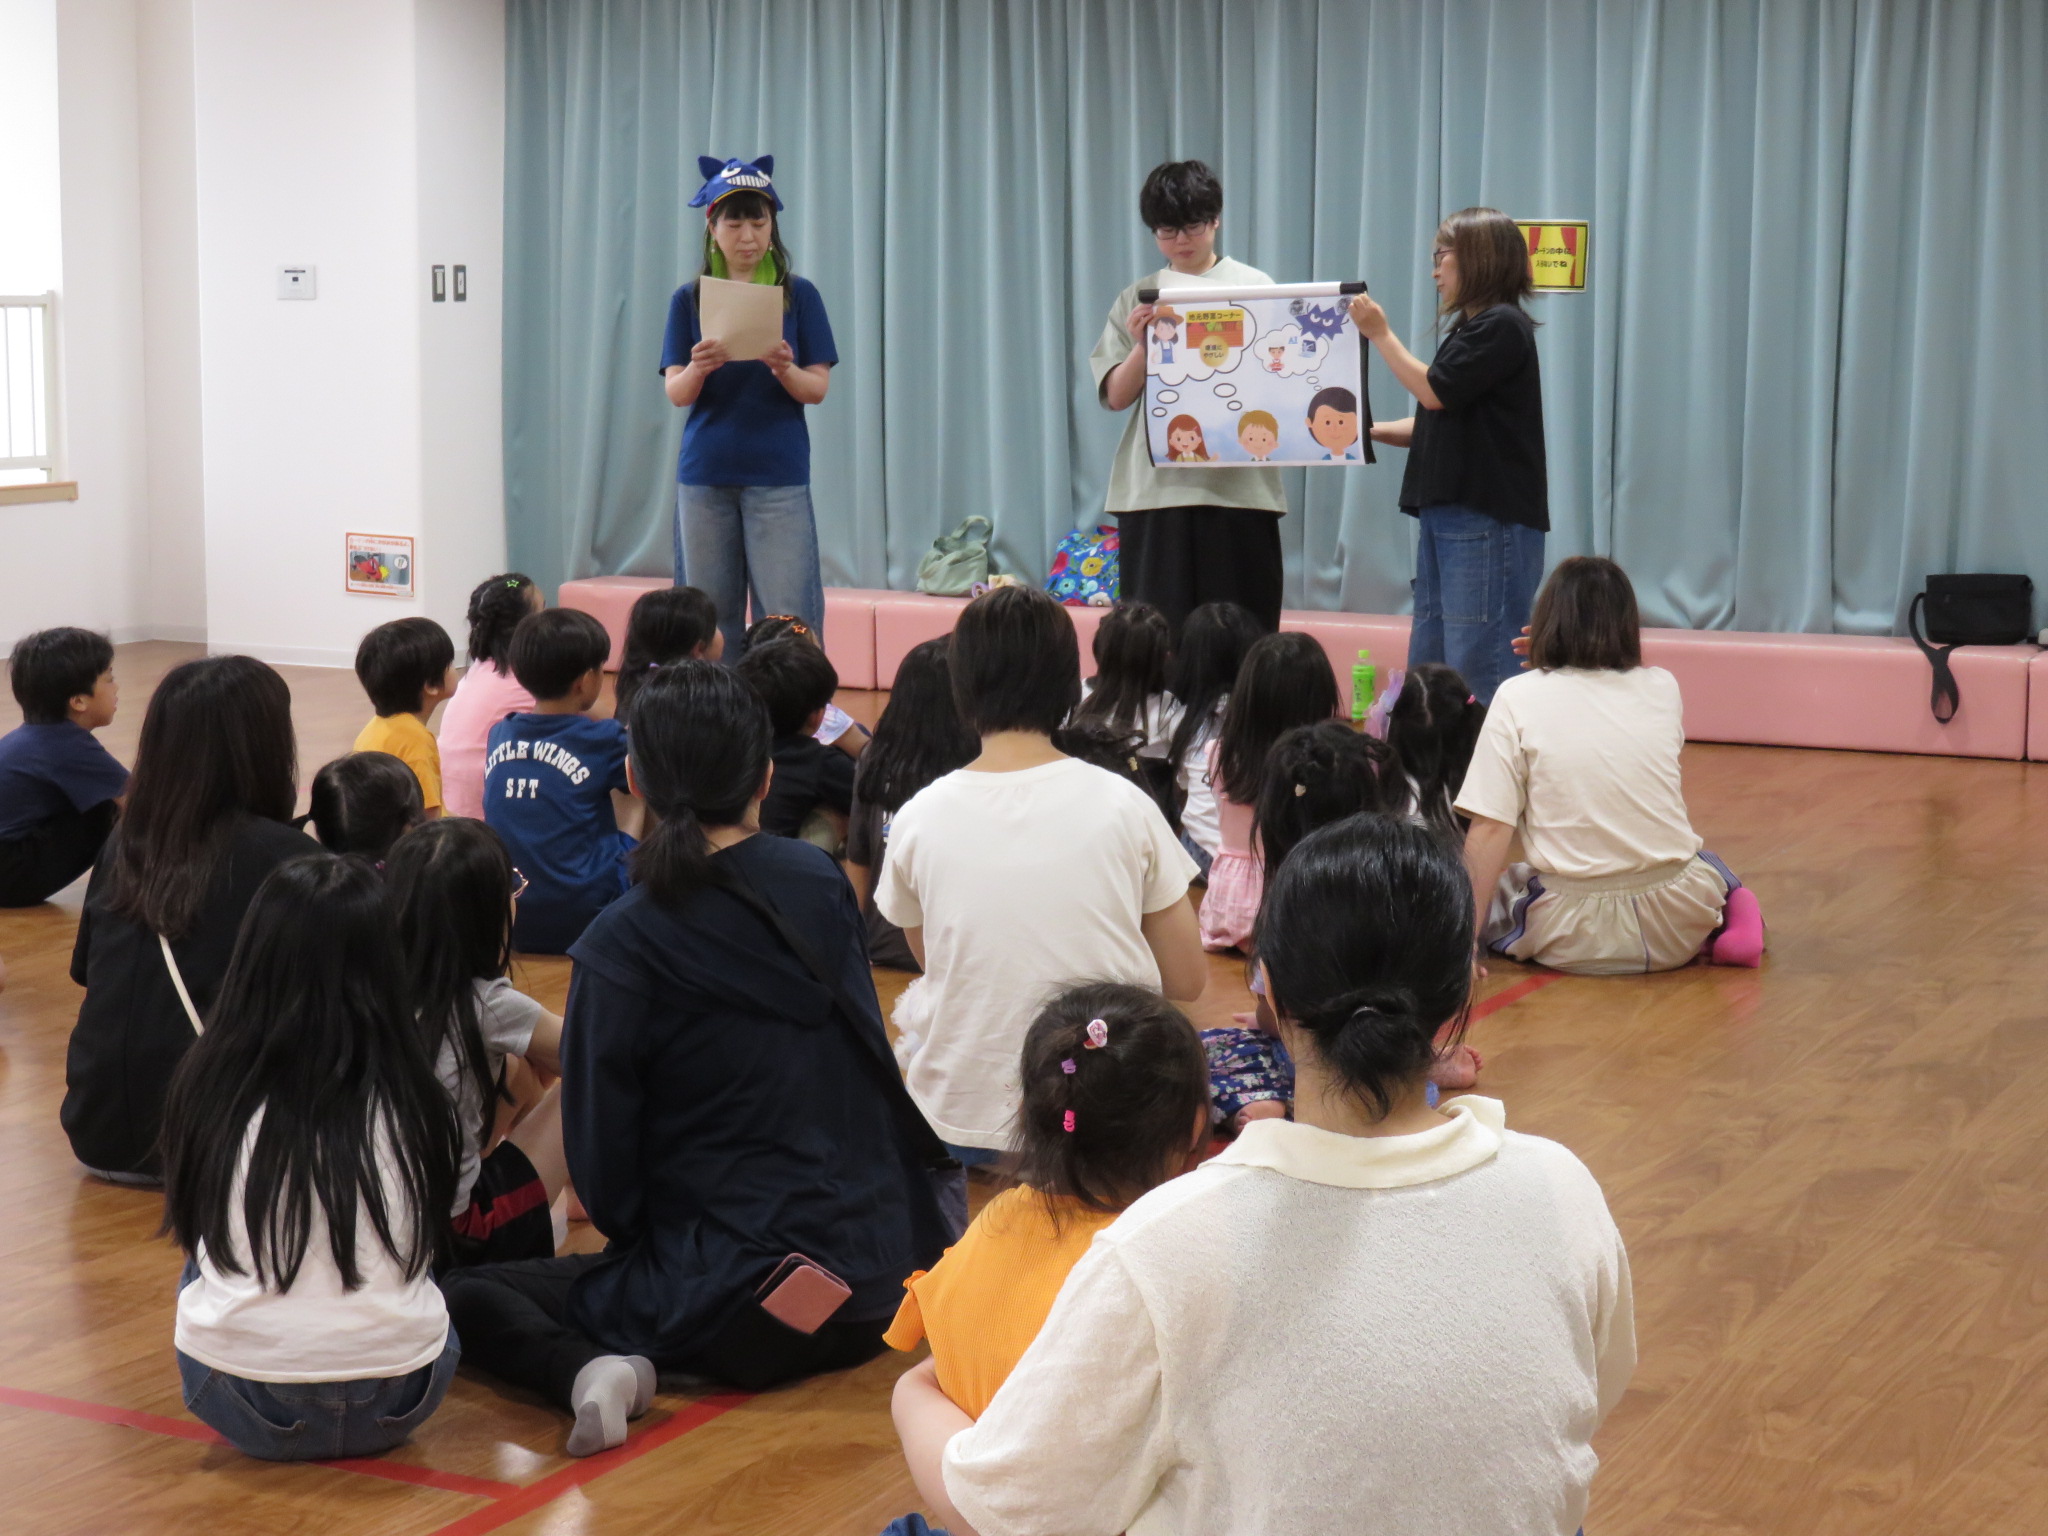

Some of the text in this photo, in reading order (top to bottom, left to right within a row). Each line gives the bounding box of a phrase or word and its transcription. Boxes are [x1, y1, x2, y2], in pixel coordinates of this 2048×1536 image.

[1188, 311, 1241, 321] 地元野菜コーナー
[484, 740, 591, 785] LITTLE WINGS
[505, 778, 539, 799] SFT
